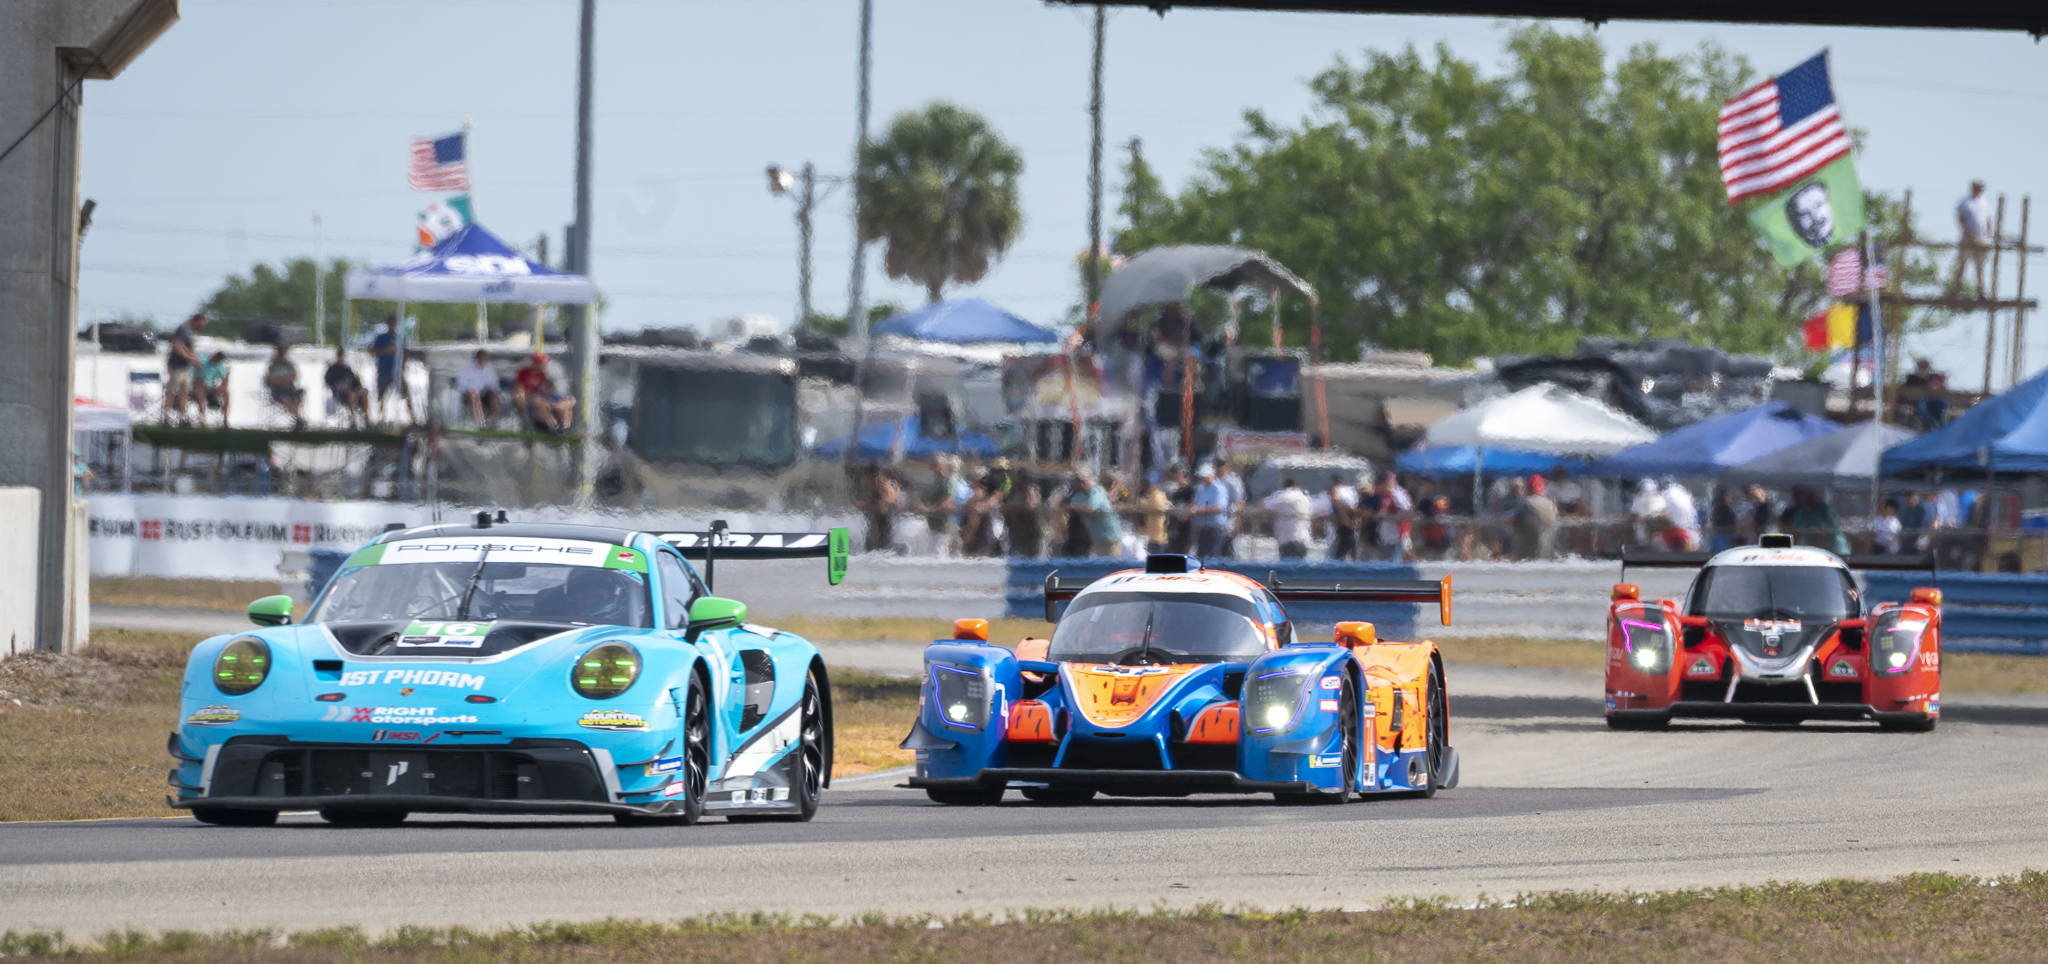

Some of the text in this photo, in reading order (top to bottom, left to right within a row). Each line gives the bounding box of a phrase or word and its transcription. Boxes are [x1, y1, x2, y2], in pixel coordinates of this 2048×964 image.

[397, 544, 595, 556] PORSCHE
[418, 623, 478, 636] 16
[338, 670, 486, 691] 1ST PHORM
[349, 714, 479, 726] Motorsports
